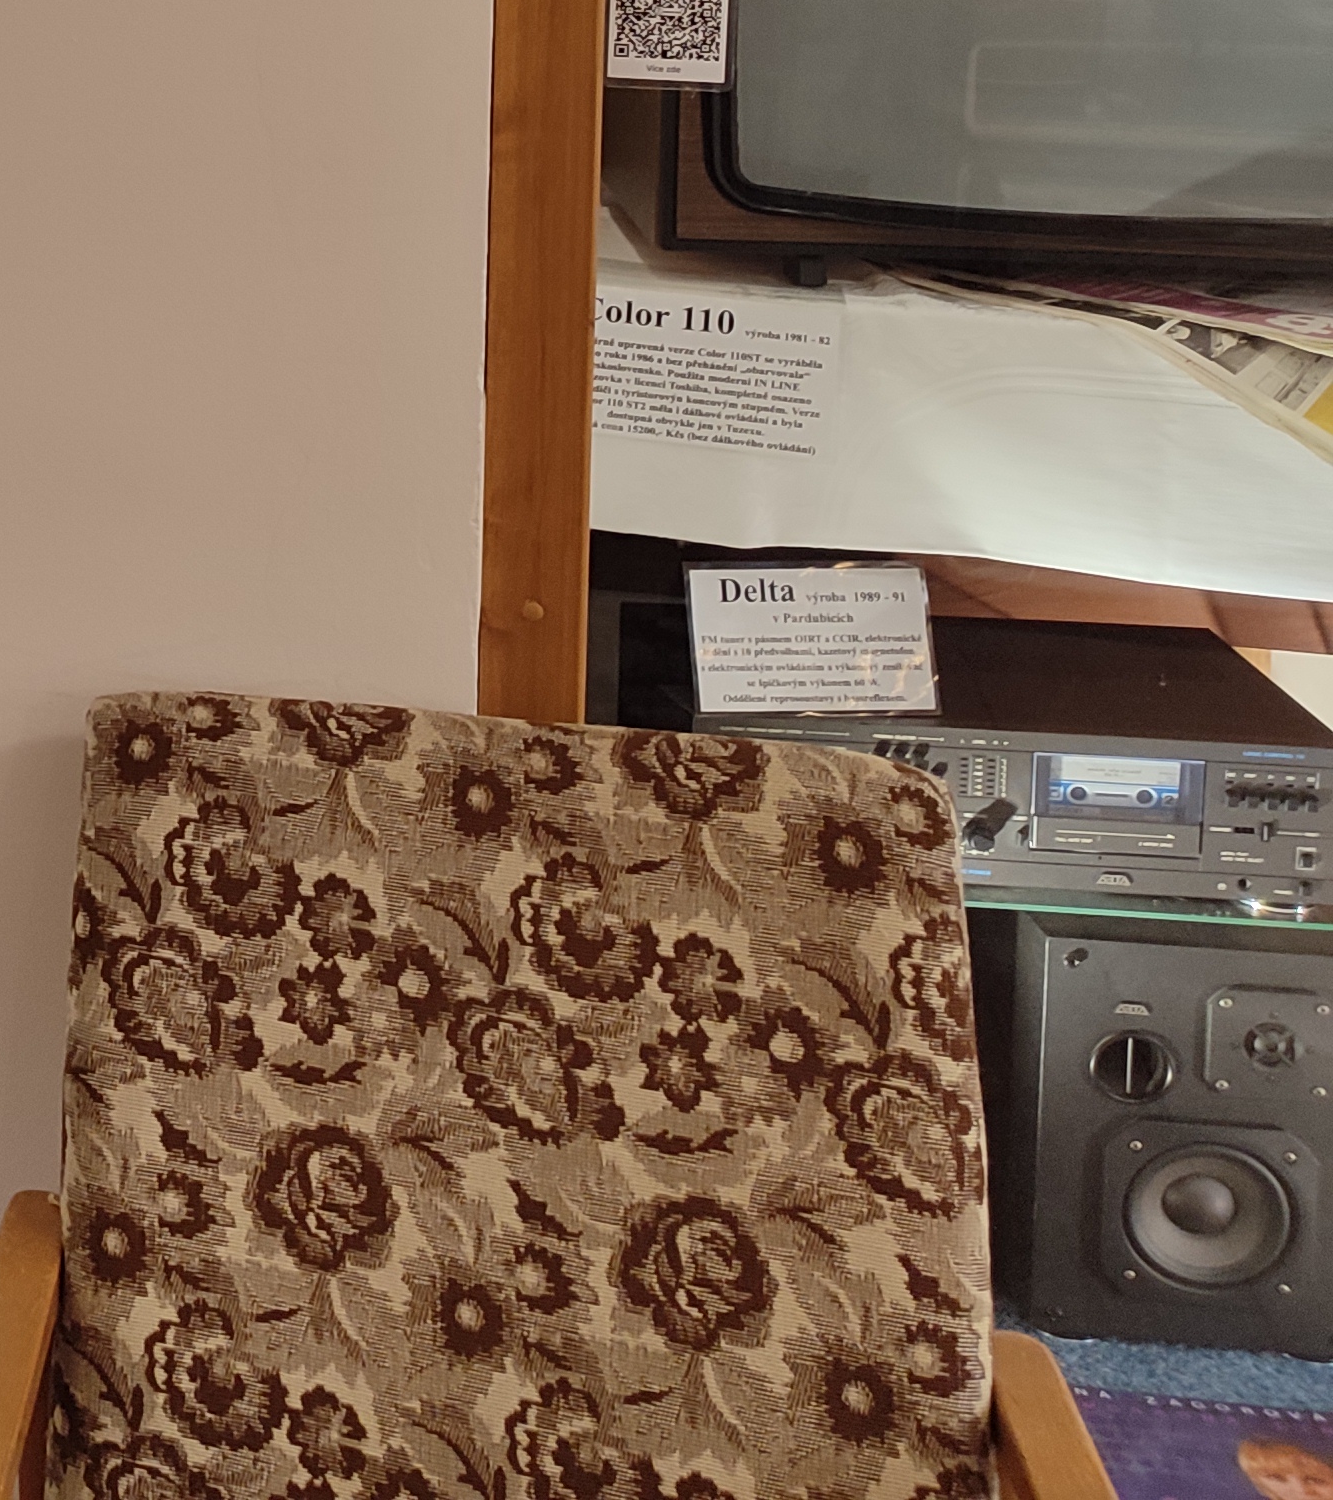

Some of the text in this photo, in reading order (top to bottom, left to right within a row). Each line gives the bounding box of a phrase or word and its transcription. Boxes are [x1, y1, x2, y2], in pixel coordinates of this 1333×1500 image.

[682, 306, 735, 335] 110
[745, 329, 780, 340] výroba
[784, 332, 808, 343] 1981
[819, 336, 831, 345] 82
[631, 353, 683, 366] 1986 bez
[698, 348, 727, 358] Color
[771, 380, 800, 391] LINE
[607, 398, 803, 429] 110 ST2 byla
[720, 578, 905, 604] Delta výroba 1989 91
[783, 612, 854, 623] Pardubicích
